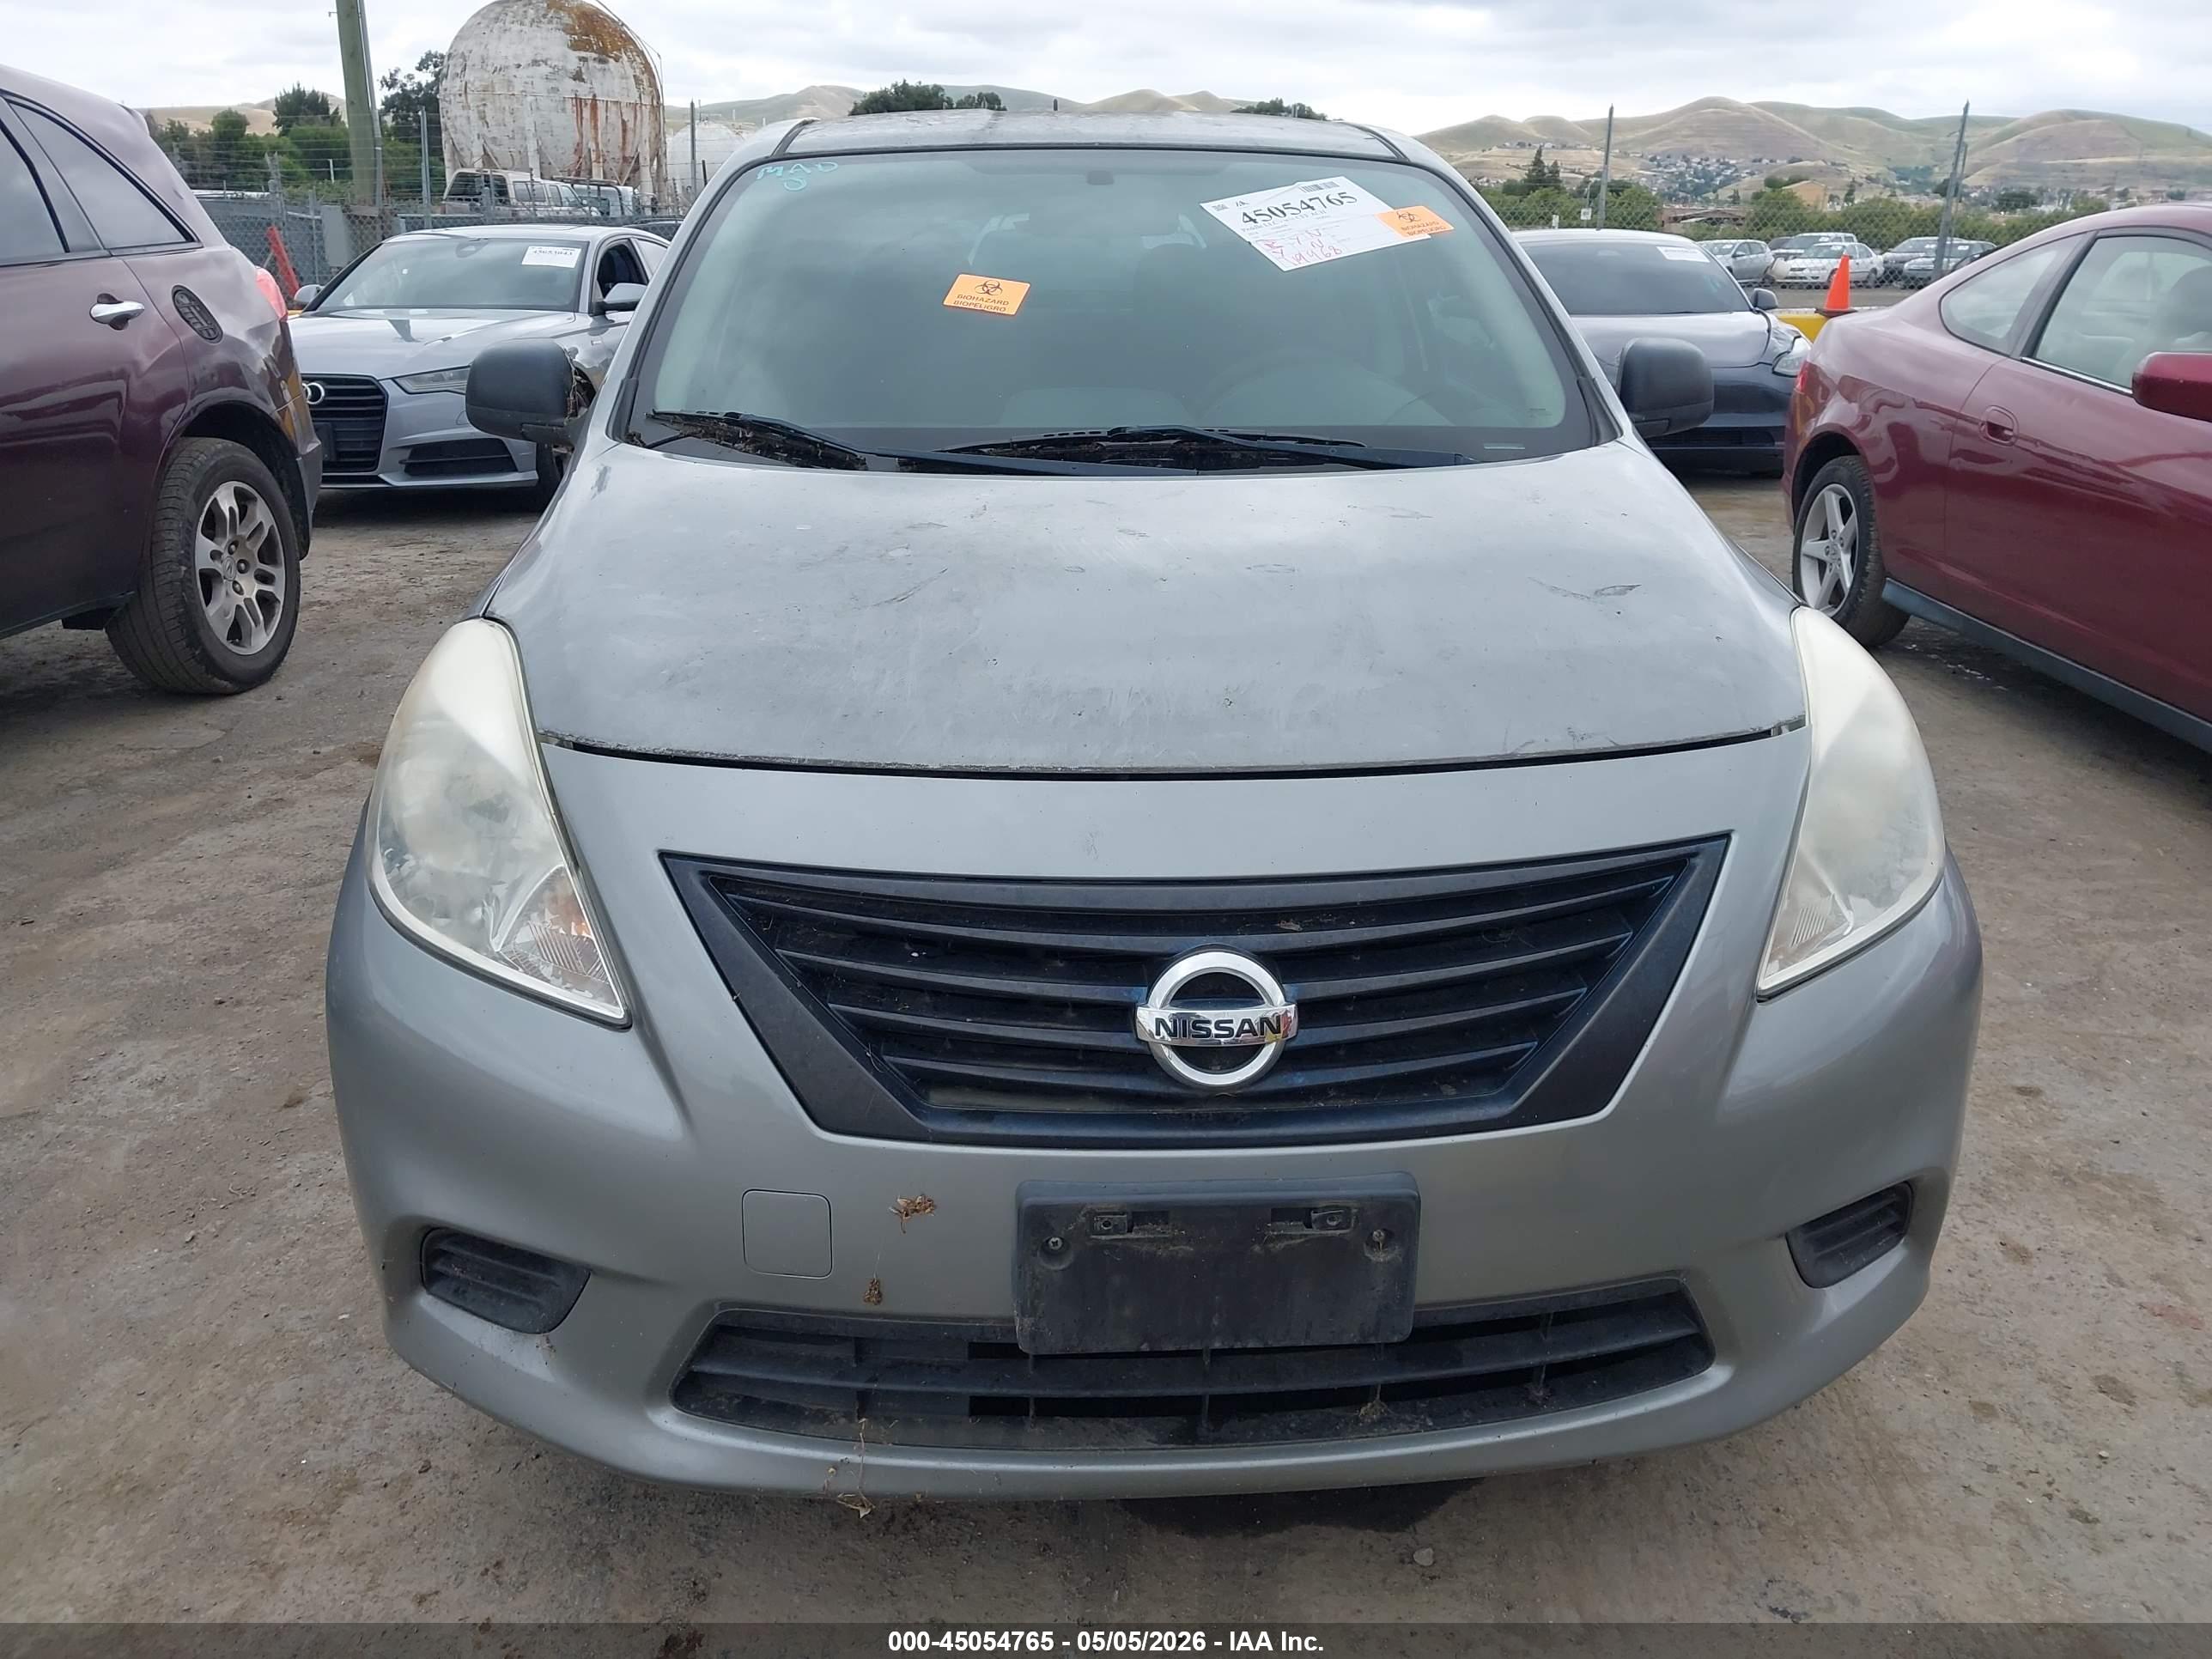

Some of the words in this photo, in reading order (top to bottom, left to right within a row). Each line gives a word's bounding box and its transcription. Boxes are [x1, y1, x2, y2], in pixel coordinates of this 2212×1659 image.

[1242, 191, 1358, 224] 45054765
[953, 300, 1007, 312] BIOPELIGRO
[957, 294, 1010, 306] BIOHAZARD
[1154, 1016, 1281, 1039] NISSAN
